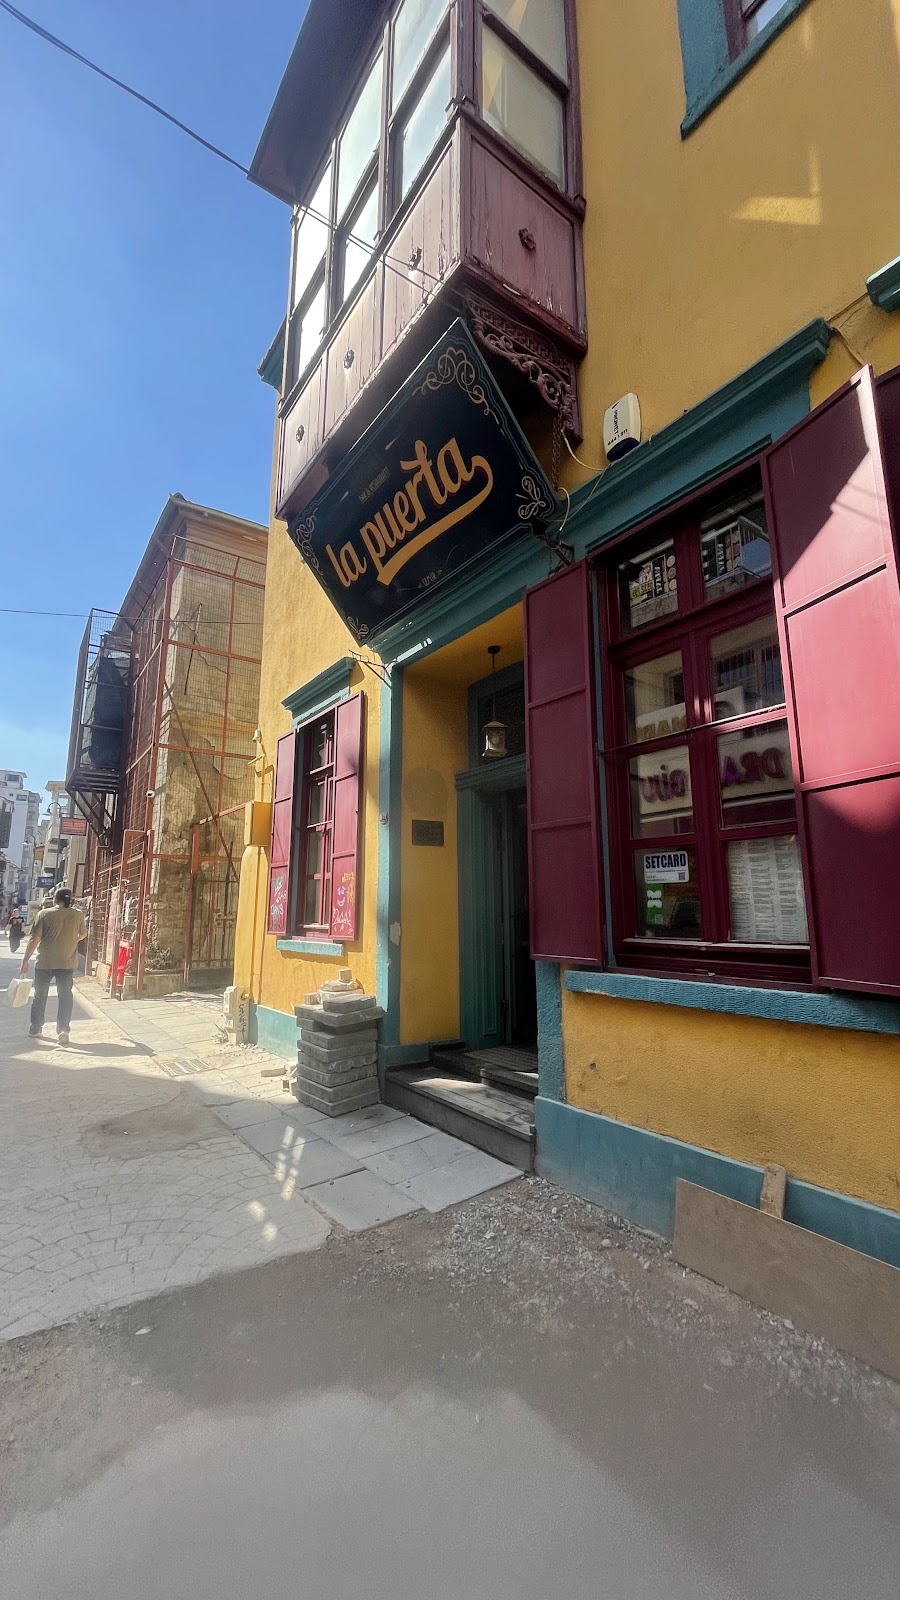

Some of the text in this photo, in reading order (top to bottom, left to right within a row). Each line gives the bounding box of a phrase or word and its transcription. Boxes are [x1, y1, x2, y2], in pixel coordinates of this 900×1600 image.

[326, 437, 493, 588] la puerta
[645, 852, 687, 870] SETCARD
